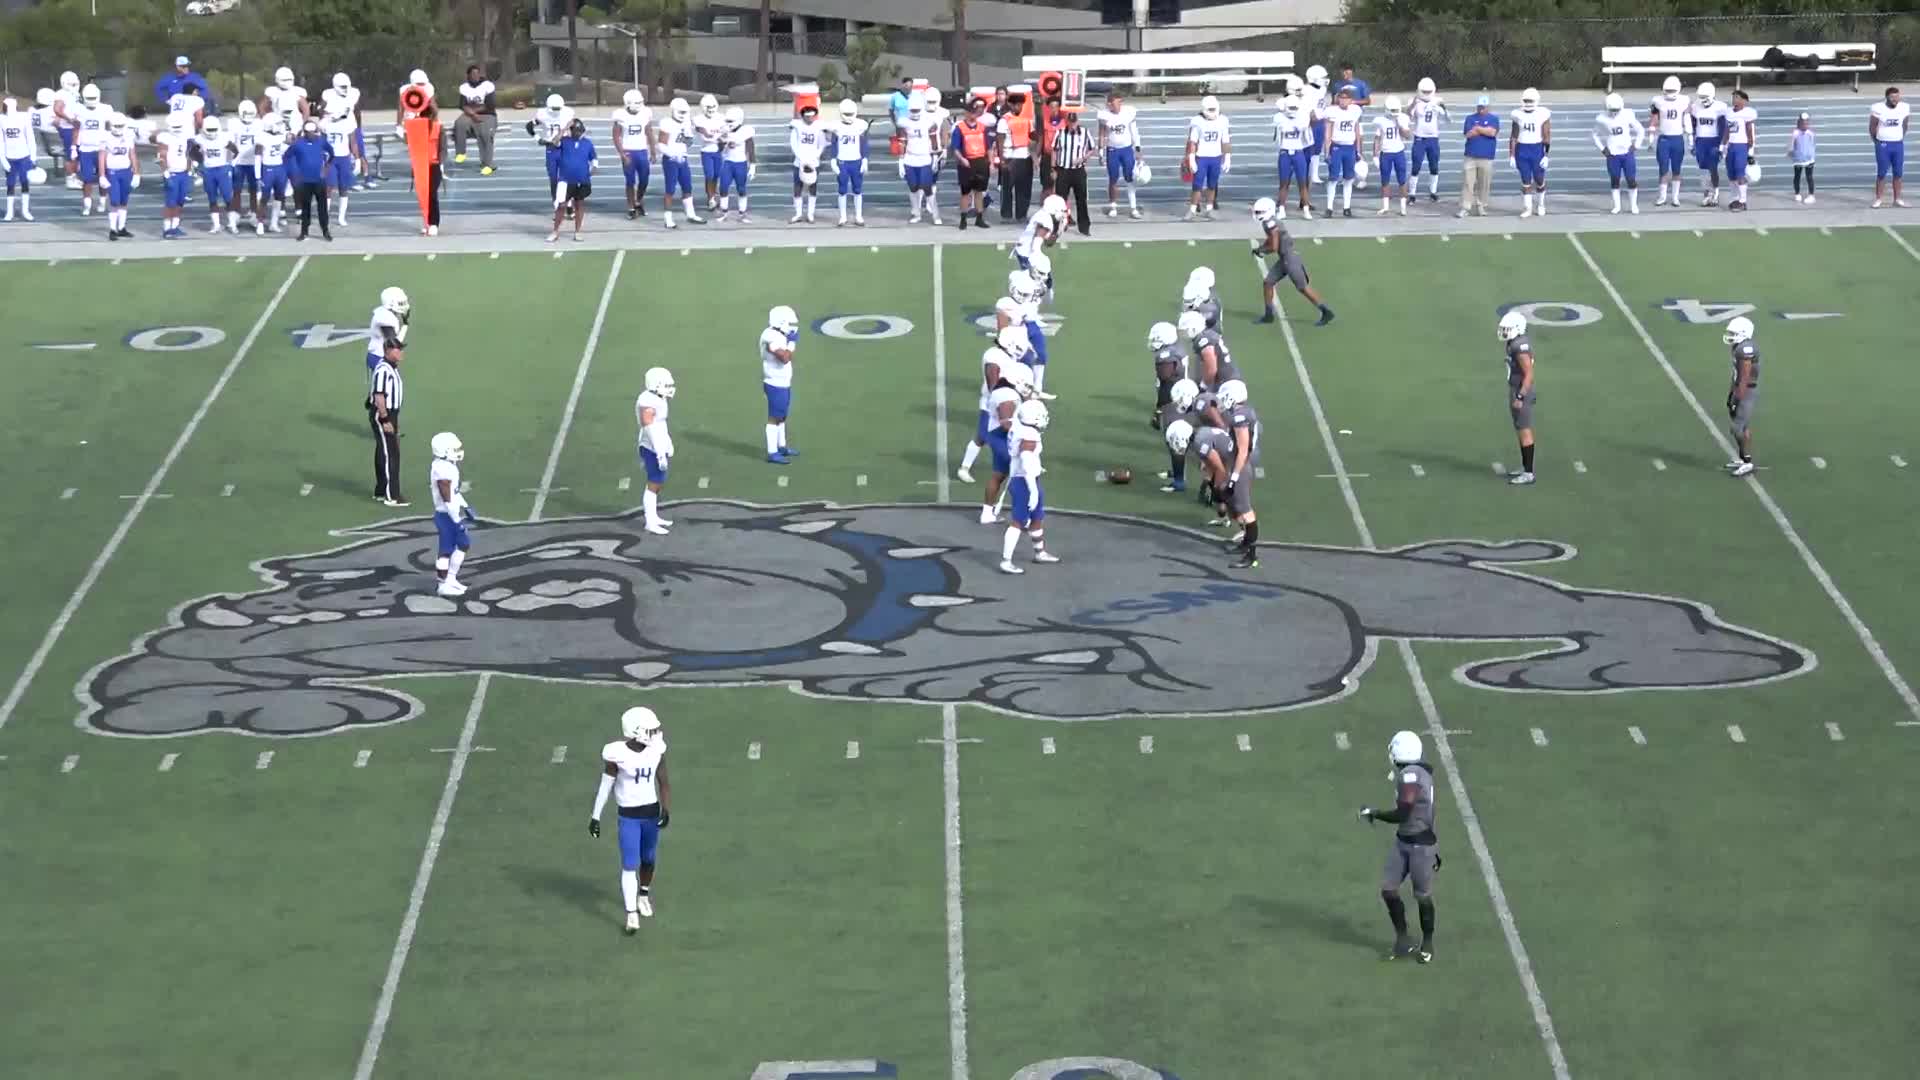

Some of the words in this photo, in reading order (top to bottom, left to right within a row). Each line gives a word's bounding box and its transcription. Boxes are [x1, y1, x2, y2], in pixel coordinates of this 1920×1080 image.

[1386, 127, 1398, 140] 81
[1523, 123, 1536, 133] 41
[634, 767, 652, 785] 14
